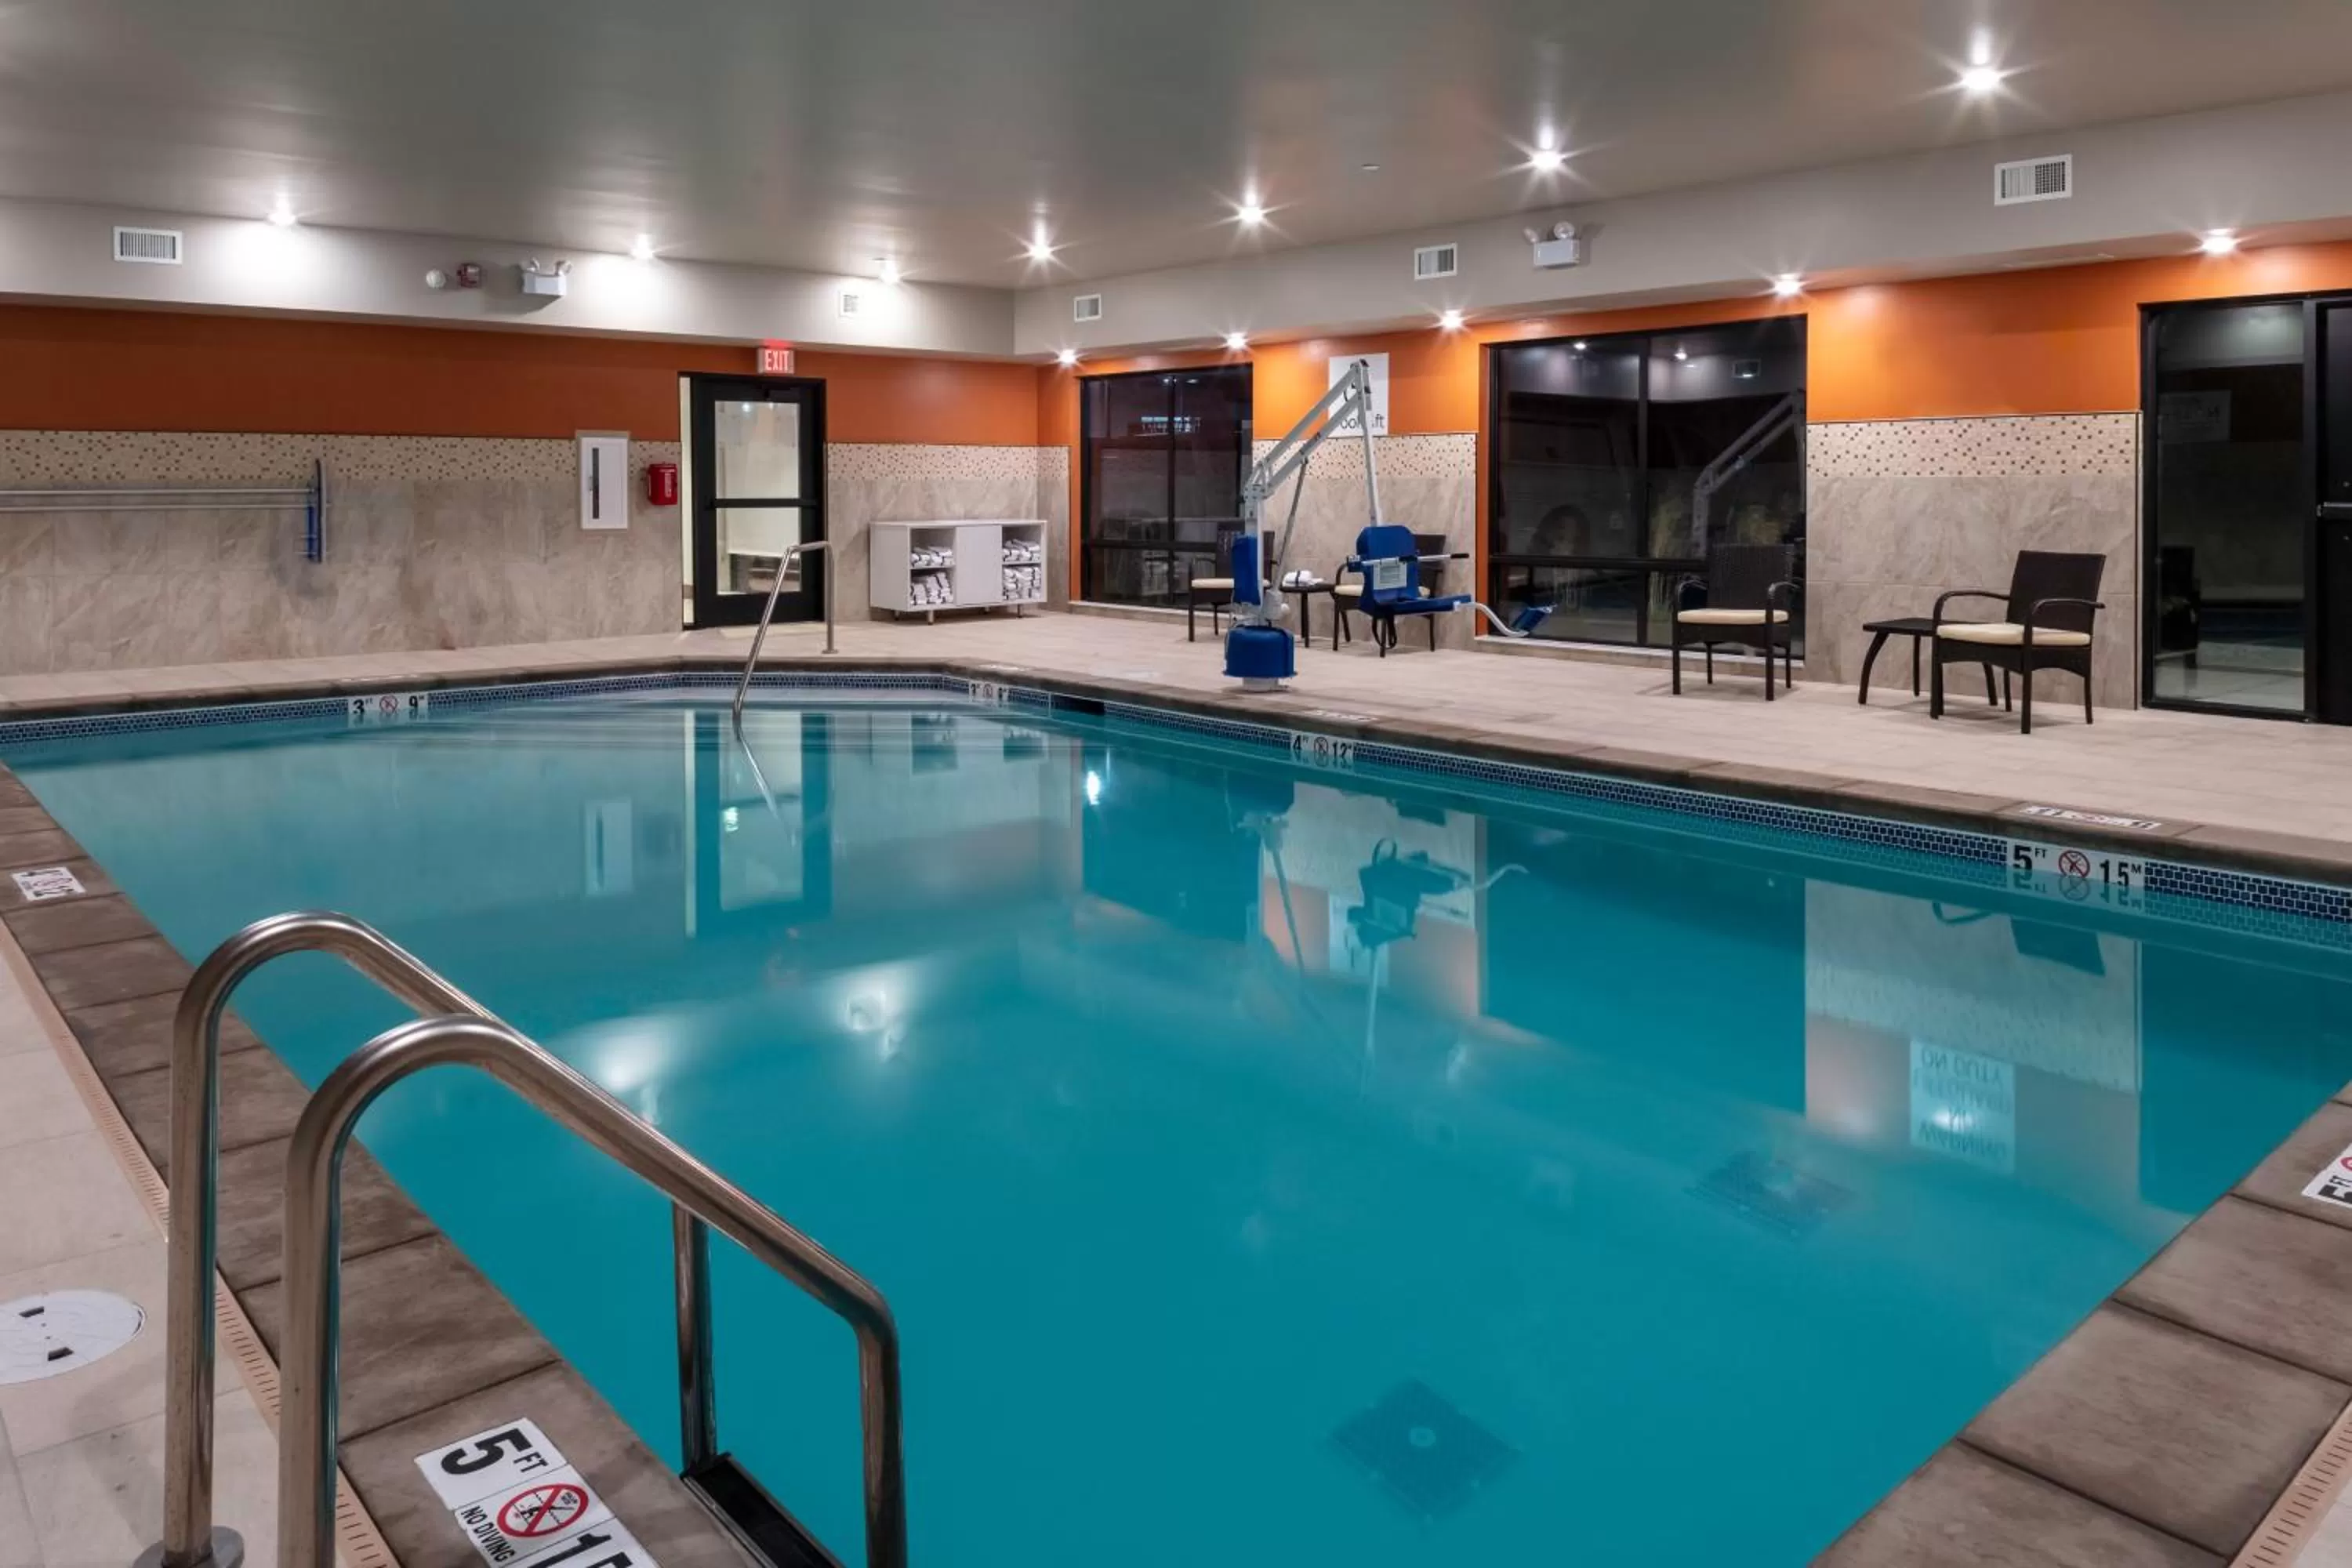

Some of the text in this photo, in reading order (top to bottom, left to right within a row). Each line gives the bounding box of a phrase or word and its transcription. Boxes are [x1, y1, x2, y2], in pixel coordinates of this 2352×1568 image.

[764, 350, 789, 371] EXIT
[353, 699, 365, 713] 3
[1293, 735, 1301, 750] 4
[2013, 844, 2048, 870] 5 FT
[2131, 863, 2141, 873] M
[441, 1428, 547, 1475] 5 FT
[460, 1505, 515, 1563] NO DIVING
